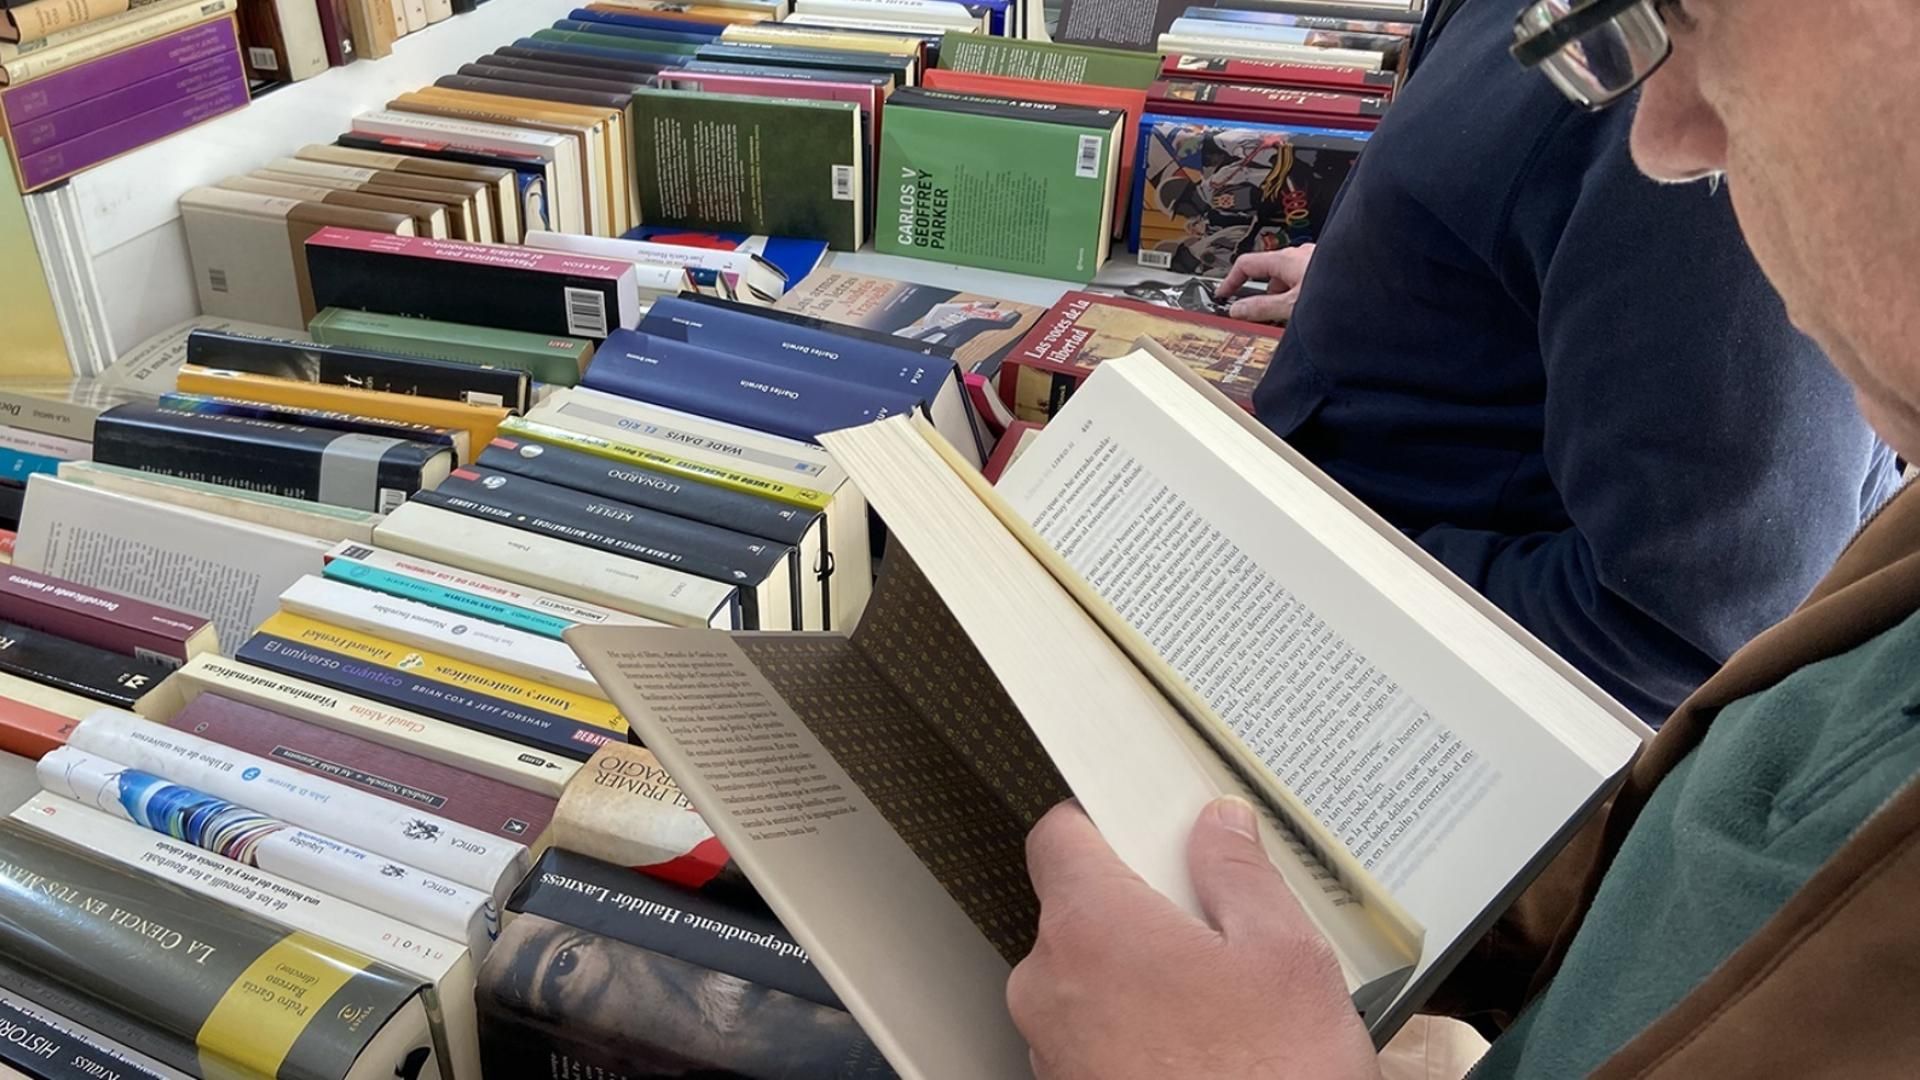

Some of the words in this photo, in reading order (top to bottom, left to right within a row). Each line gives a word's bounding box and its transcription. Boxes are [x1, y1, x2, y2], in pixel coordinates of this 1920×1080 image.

[1267, 92, 1305, 105] Las
[902, 167, 917, 179] V
[898, 184, 915, 244] CARLOS
[914, 170, 932, 247] GEOFFREY
[931, 188, 948, 250] PARKER
[422, 239, 486, 255] económico
[435, 246, 462, 258] para
[489, 247, 532, 260] análisis
[463, 251, 537, 268] Matemáticas
[561, 259, 610, 271] PEARSON
[1024, 341, 1052, 360] Las
[1065, 307, 1082, 324] de
[1076, 299, 1091, 314] la
[781, 341, 809, 353] Darwin
[809, 347, 838, 360] Charles
[1047, 328, 1090, 364] libertad
[739, 379, 768, 392] Darwin
[768, 385, 799, 400] Charles
[616, 418, 641, 433] RÍO
[642, 424, 658, 435] EL
[664, 430, 703, 446] DAVIS
[704, 439, 742, 456] WADE
[607, 467, 680, 494] LEONARDO
[585, 501, 633, 524] KEPLER
[530, 518, 587, 539] MATEMÁTICAS
[587, 532, 602, 542] LAS
[602, 536, 612, 545] DE
[613, 538, 646, 553] NOVELA
[646, 547, 669, 559] GRAN
[670, 553, 681, 562] LA
[7, 573, 44, 591] universo
[52, 586, 118, 613] Descodificando
[301, 627, 346, 649] Frenkel
[344, 639, 392, 661] Edward
[263, 639, 281, 654] El
[279, 643, 340, 671] universo
[341, 660, 404, 688] cuántico
[201, 660, 276, 692] matemáticas
[434, 664, 524, 698] matemáticas
[275, 681, 338, 710] Vitaminas
[534, 692, 572, 712] Amor
[347, 702, 387, 724] Alsina
[411, 683, 442, 699] BRIAN
[443, 692, 465, 705] COX
[465, 698, 473, 708] &
[474, 701, 498, 715] JEFF
[498, 708, 551, 730] FORSHAW
[386, 713, 426, 735] Claudi
[130, 730, 172, 751] universos
[170, 744, 187, 757] los
[185, 749, 198, 761] de
[198, 753, 221, 769] libro
[220, 760, 234, 773] El
[598, 746, 681, 798] RAGIO
[593, 764, 668, 807] PRIMER
[671, 790, 691, 809] EL
[154, 840, 183, 858] cálculo
[449, 835, 487, 858] CRÍTICA
[141, 849, 187, 876] Bourbaki
[182, 850, 197, 863] del
[196, 855, 224, 872] ciencia
[186, 866, 202, 880] los
[201, 871, 212, 881] a
[223, 865, 233, 876] la
[238, 871, 257, 884] arte
[210, 873, 257, 901] Bernoulli
[256, 877, 271, 890] del
[270, 882, 303, 902] historia
[421, 877, 456, 898] CRÍTICA
[538, 867, 609, 905] Laxness
[255, 892, 273, 907] los
[271, 898, 288, 913] de
[302, 894, 320, 906] una
[609, 888, 680, 926] Halldór
[682, 906, 811, 966] independiente
[380, 929, 443, 964] nivola
[274, 960, 319, 988] (director)
[240, 979, 275, 1003] García
[264, 972, 307, 999] Barreno
[275, 994, 308, 1017] Pedro
